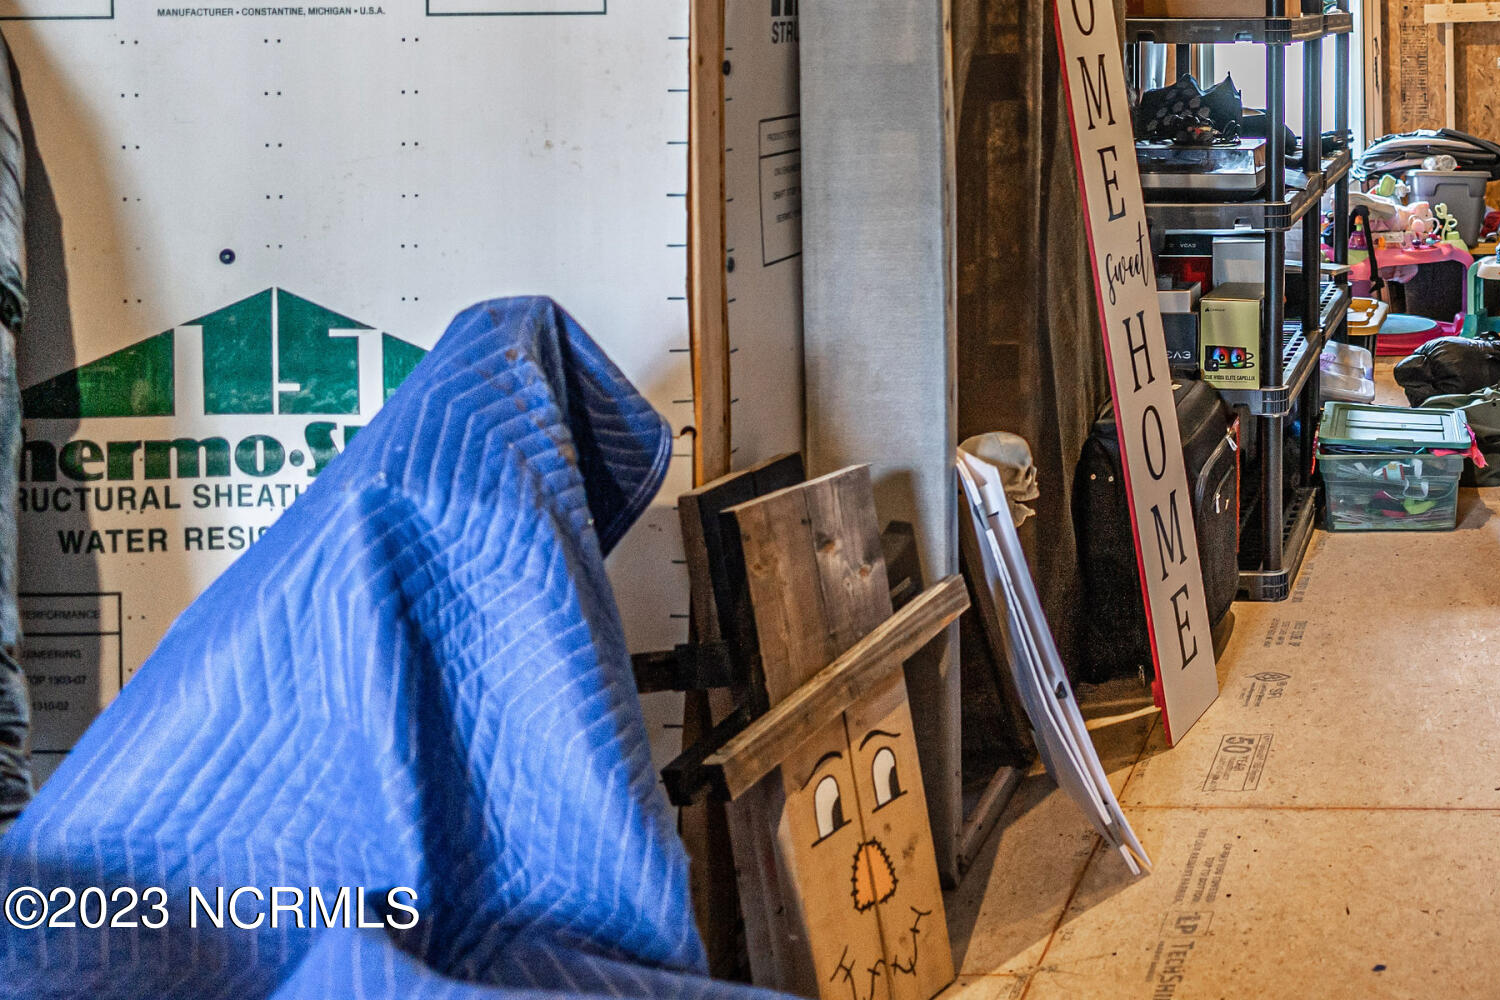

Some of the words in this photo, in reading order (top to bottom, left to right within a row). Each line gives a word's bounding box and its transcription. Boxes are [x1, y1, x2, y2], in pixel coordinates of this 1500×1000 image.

[157, 8, 234, 17] MANUFACTURER
[241, 7, 306, 16] CONSTANTINE,
[308, 7, 351, 16] MICHIGAN
[360, 7, 386, 15] U.S.A.
[1166, 350, 1191, 359] EVG
[58, 527, 168, 554] WATER
[1222, 736, 1255, 753] 50
[1175, 911, 1200, 935] LP
[1152, 940, 1196, 1000] TECHSHI
